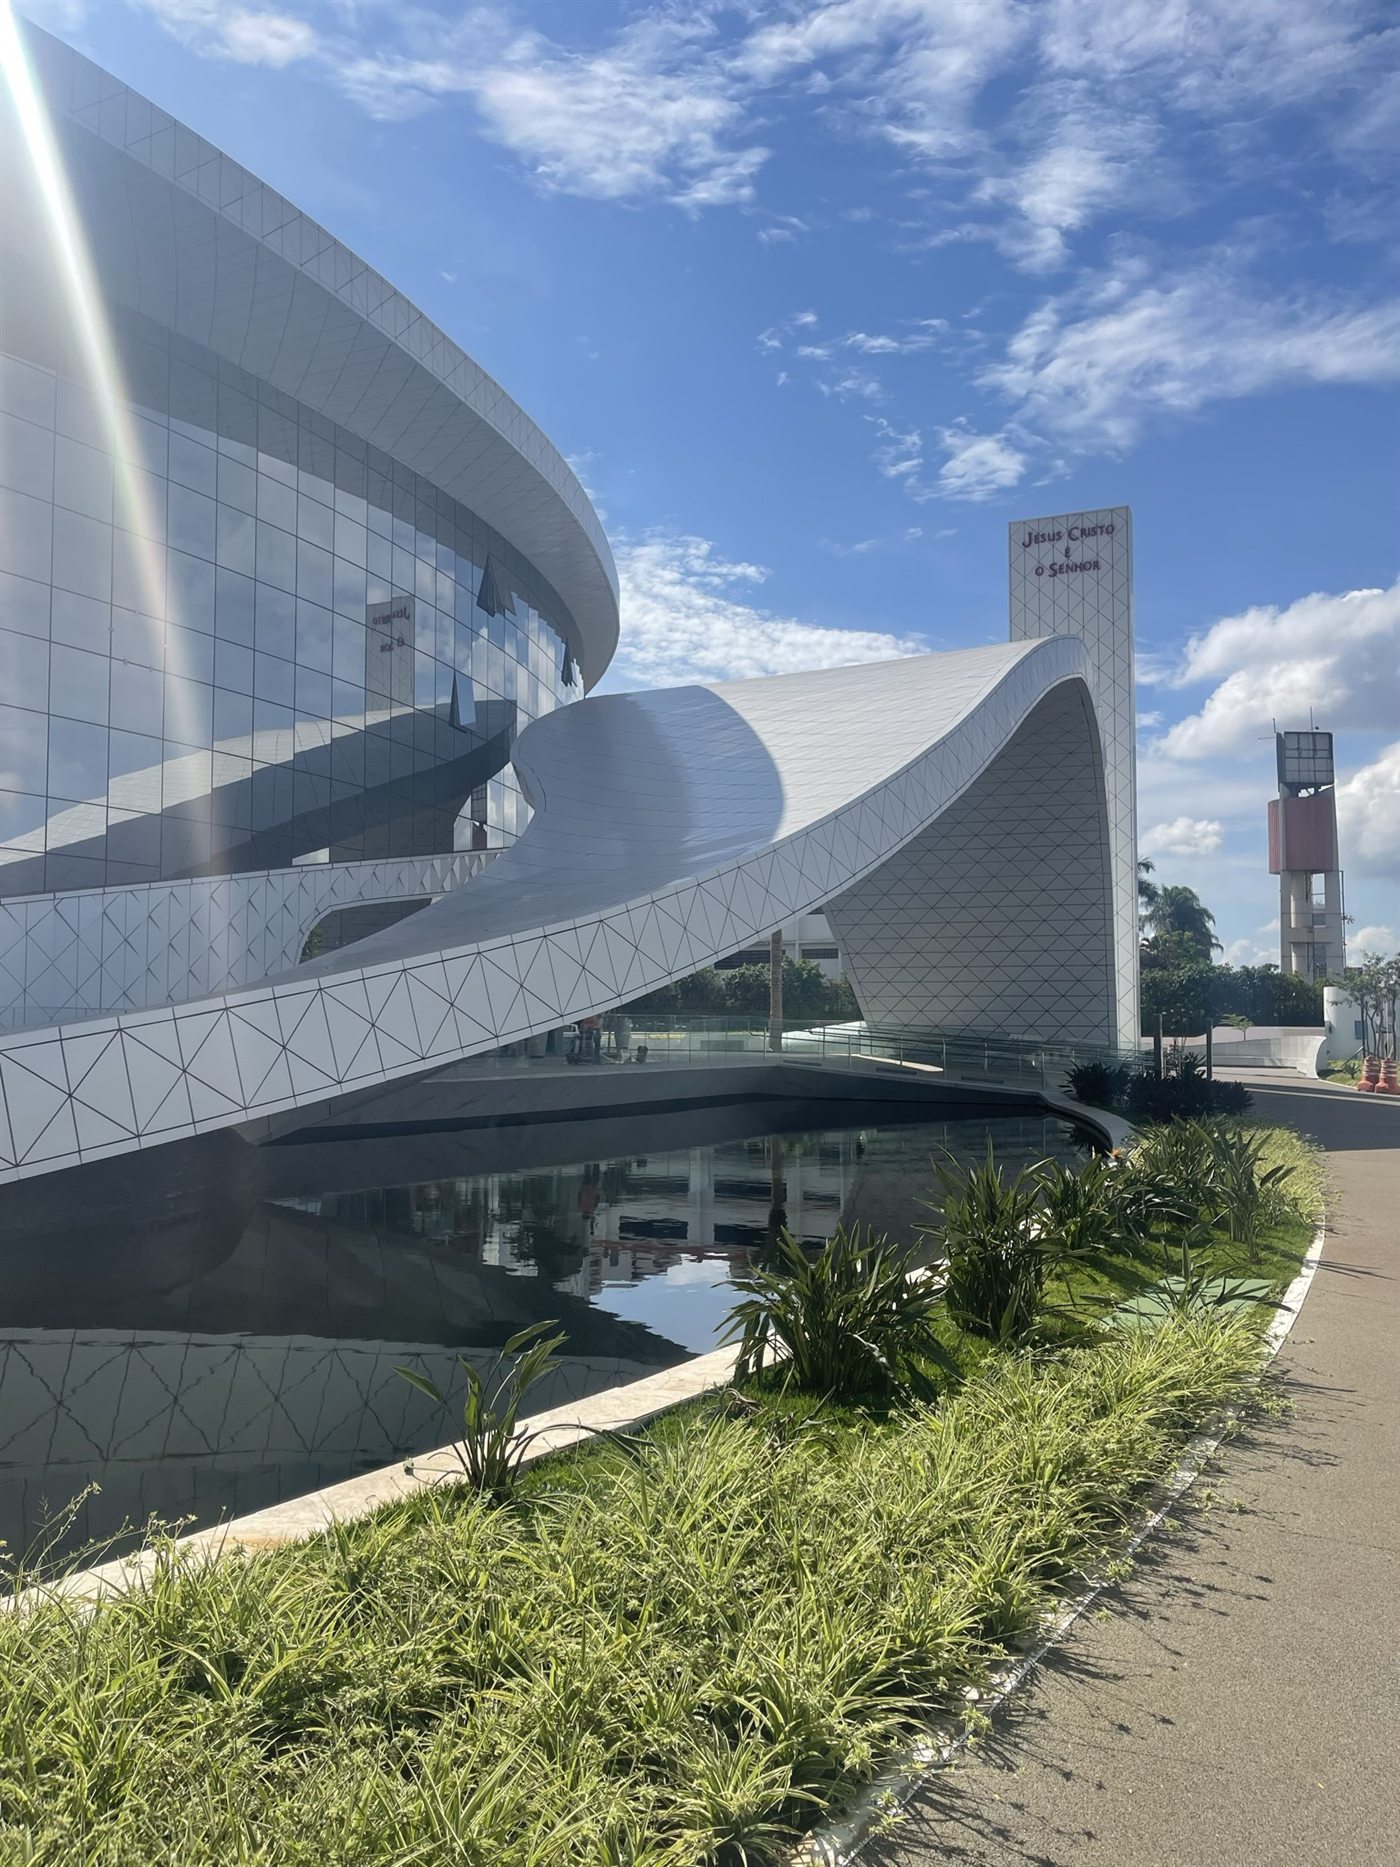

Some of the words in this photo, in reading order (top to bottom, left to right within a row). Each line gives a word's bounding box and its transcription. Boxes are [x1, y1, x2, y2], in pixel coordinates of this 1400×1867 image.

[1022, 531, 1062, 549] JESUS
[1067, 524, 1115, 541] CRISTO
[1035, 566, 1044, 576] O
[1048, 560, 1100, 577] SENHOR
